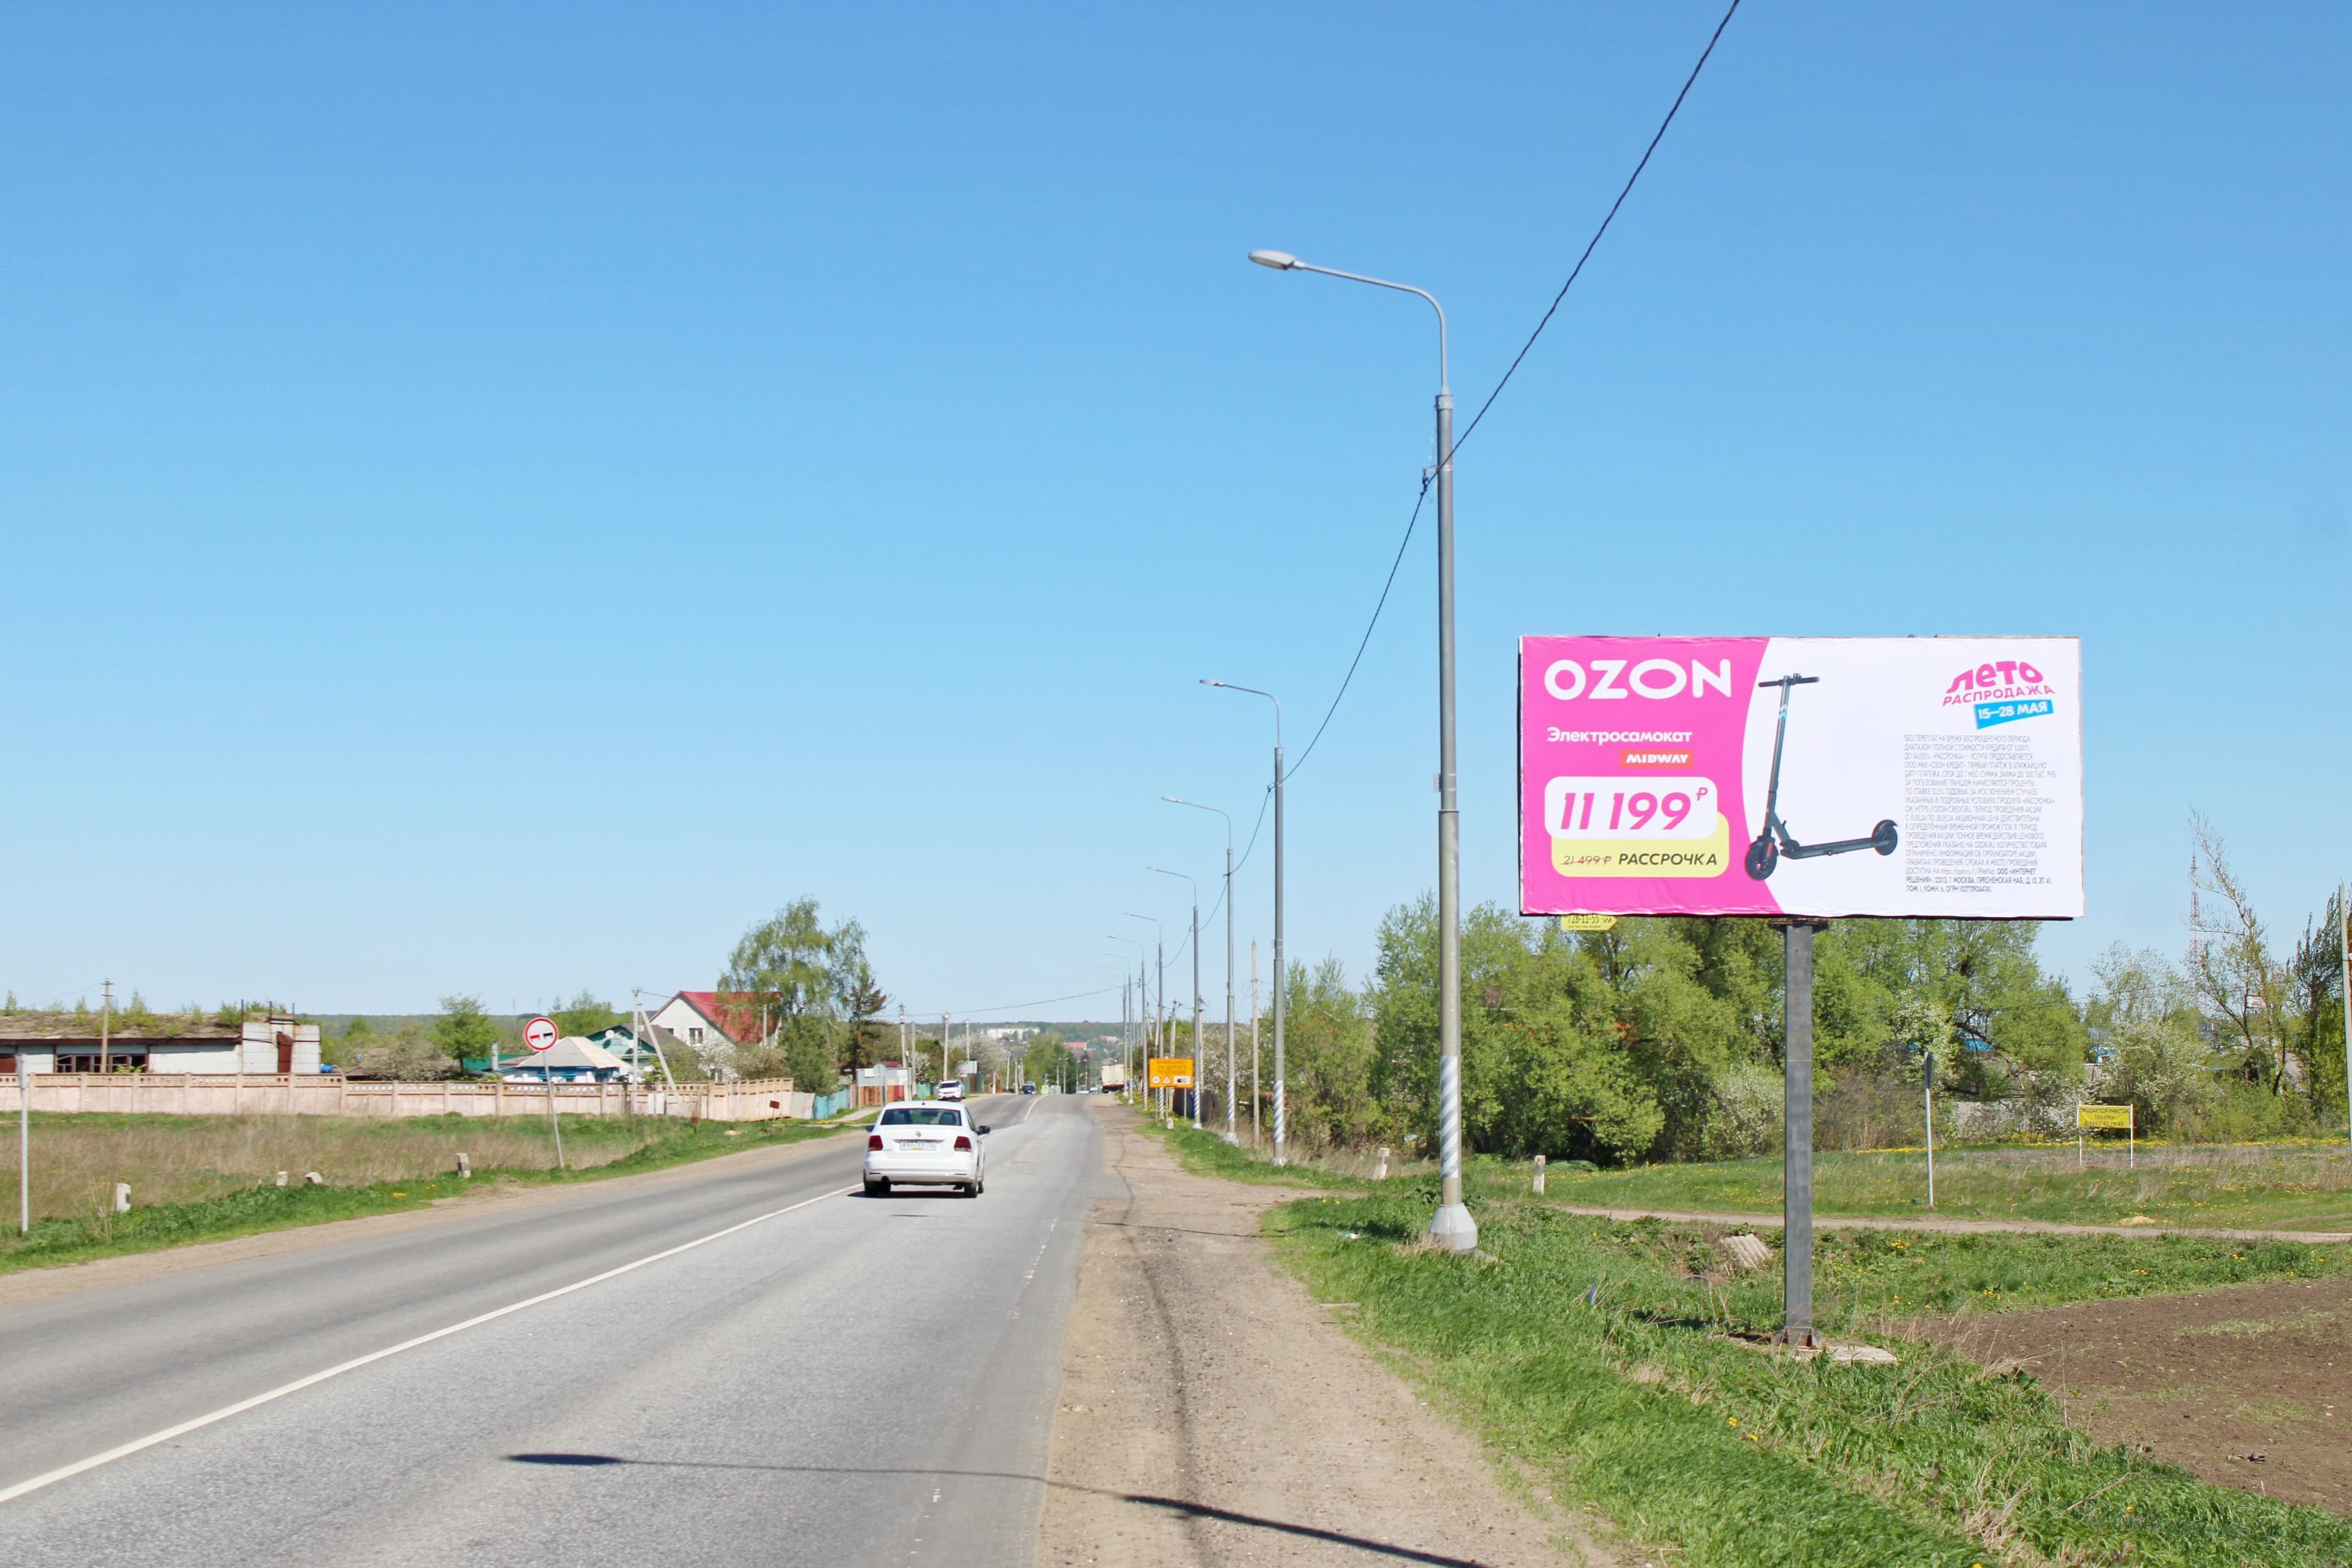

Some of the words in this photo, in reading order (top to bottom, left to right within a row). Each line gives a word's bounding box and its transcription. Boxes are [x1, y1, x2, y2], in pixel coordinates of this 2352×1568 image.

[1544, 658, 1732, 700] OZON
[1942, 685, 2056, 706] РАСПРОДАЖА
[2017, 701, 2048, 714] МАЯ
[1547, 727, 1692, 745] Электросамокат
[1625, 753, 1690, 764] MIDWAY
[1560, 793, 1594, 830] 11
[1608, 793, 1691, 830] 199
[1618, 853, 1717, 865] РАССРОЧКА
